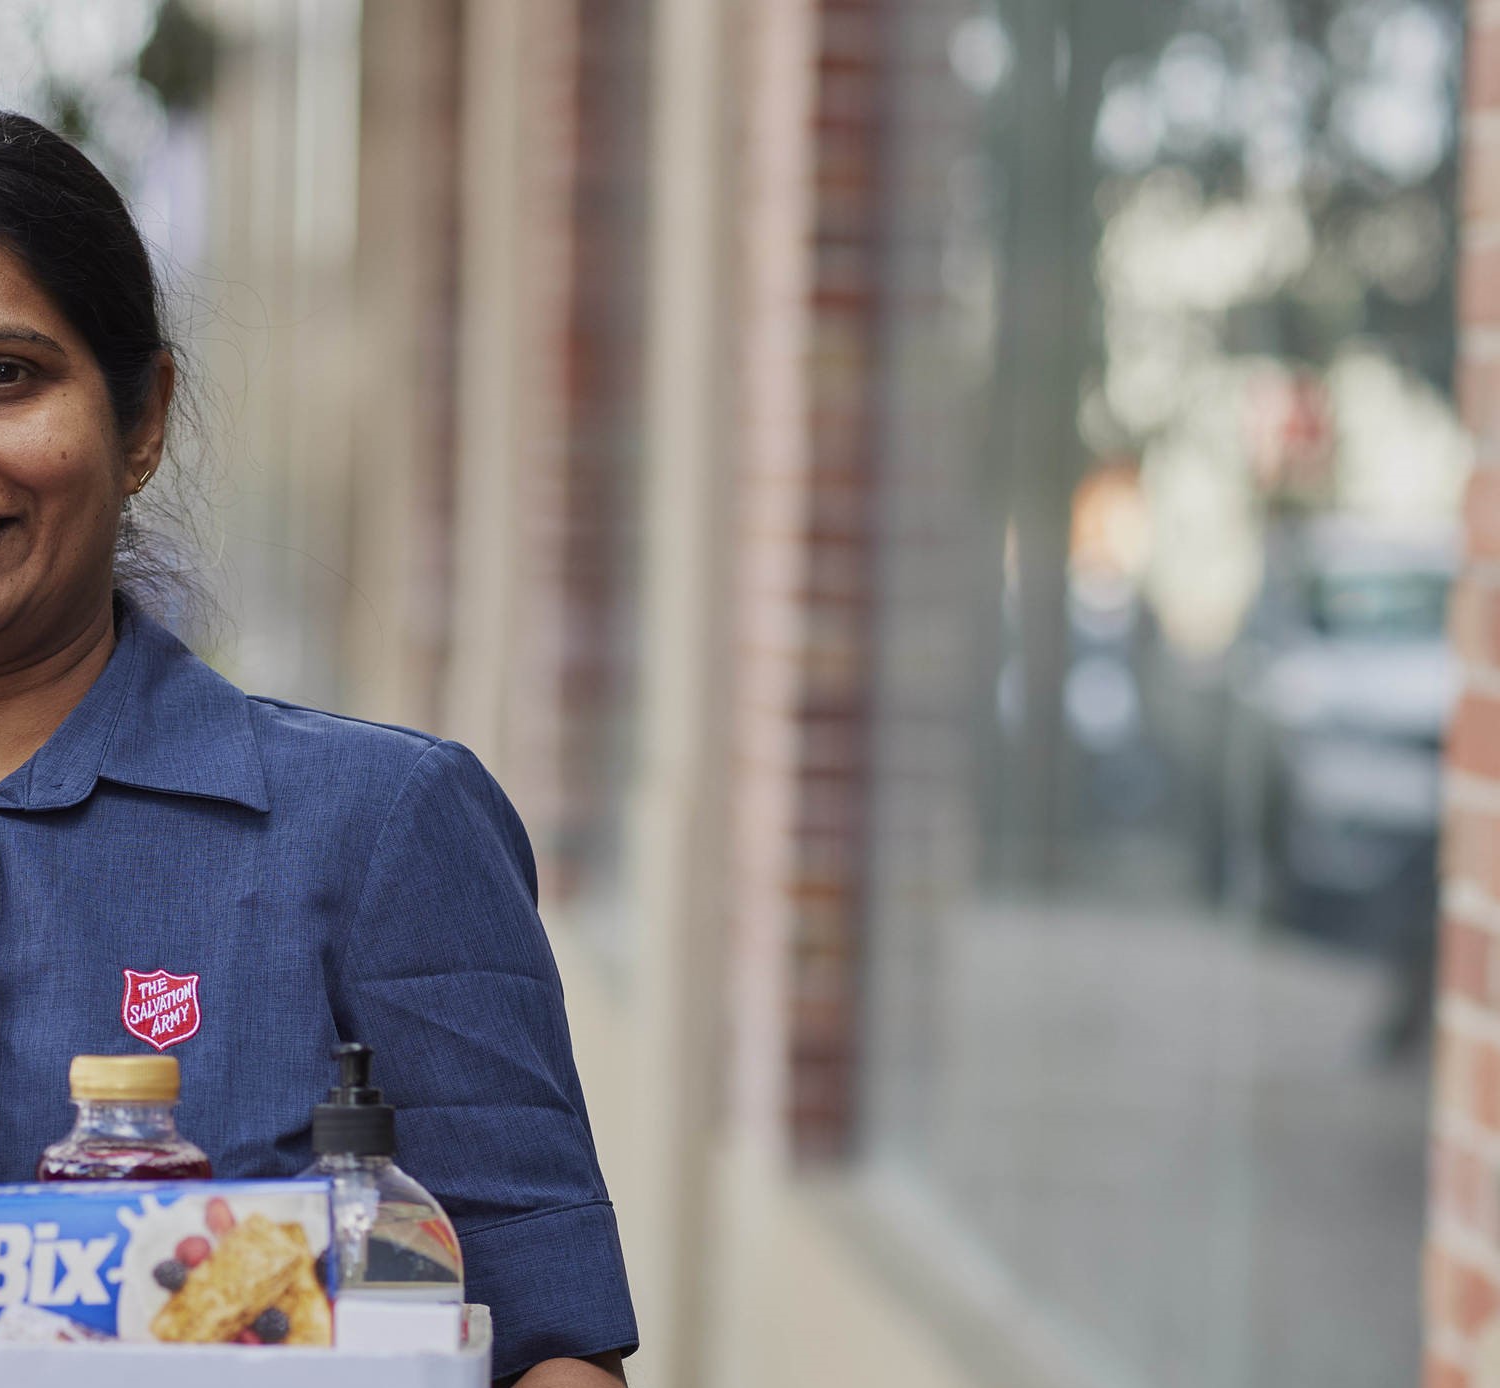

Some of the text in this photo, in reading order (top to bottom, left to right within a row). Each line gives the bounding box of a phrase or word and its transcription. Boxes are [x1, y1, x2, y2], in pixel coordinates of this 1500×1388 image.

[130, 982, 192, 1024] SALVATION
[138, 977, 168, 999] THE
[151, 1003, 189, 1037] ARMY
